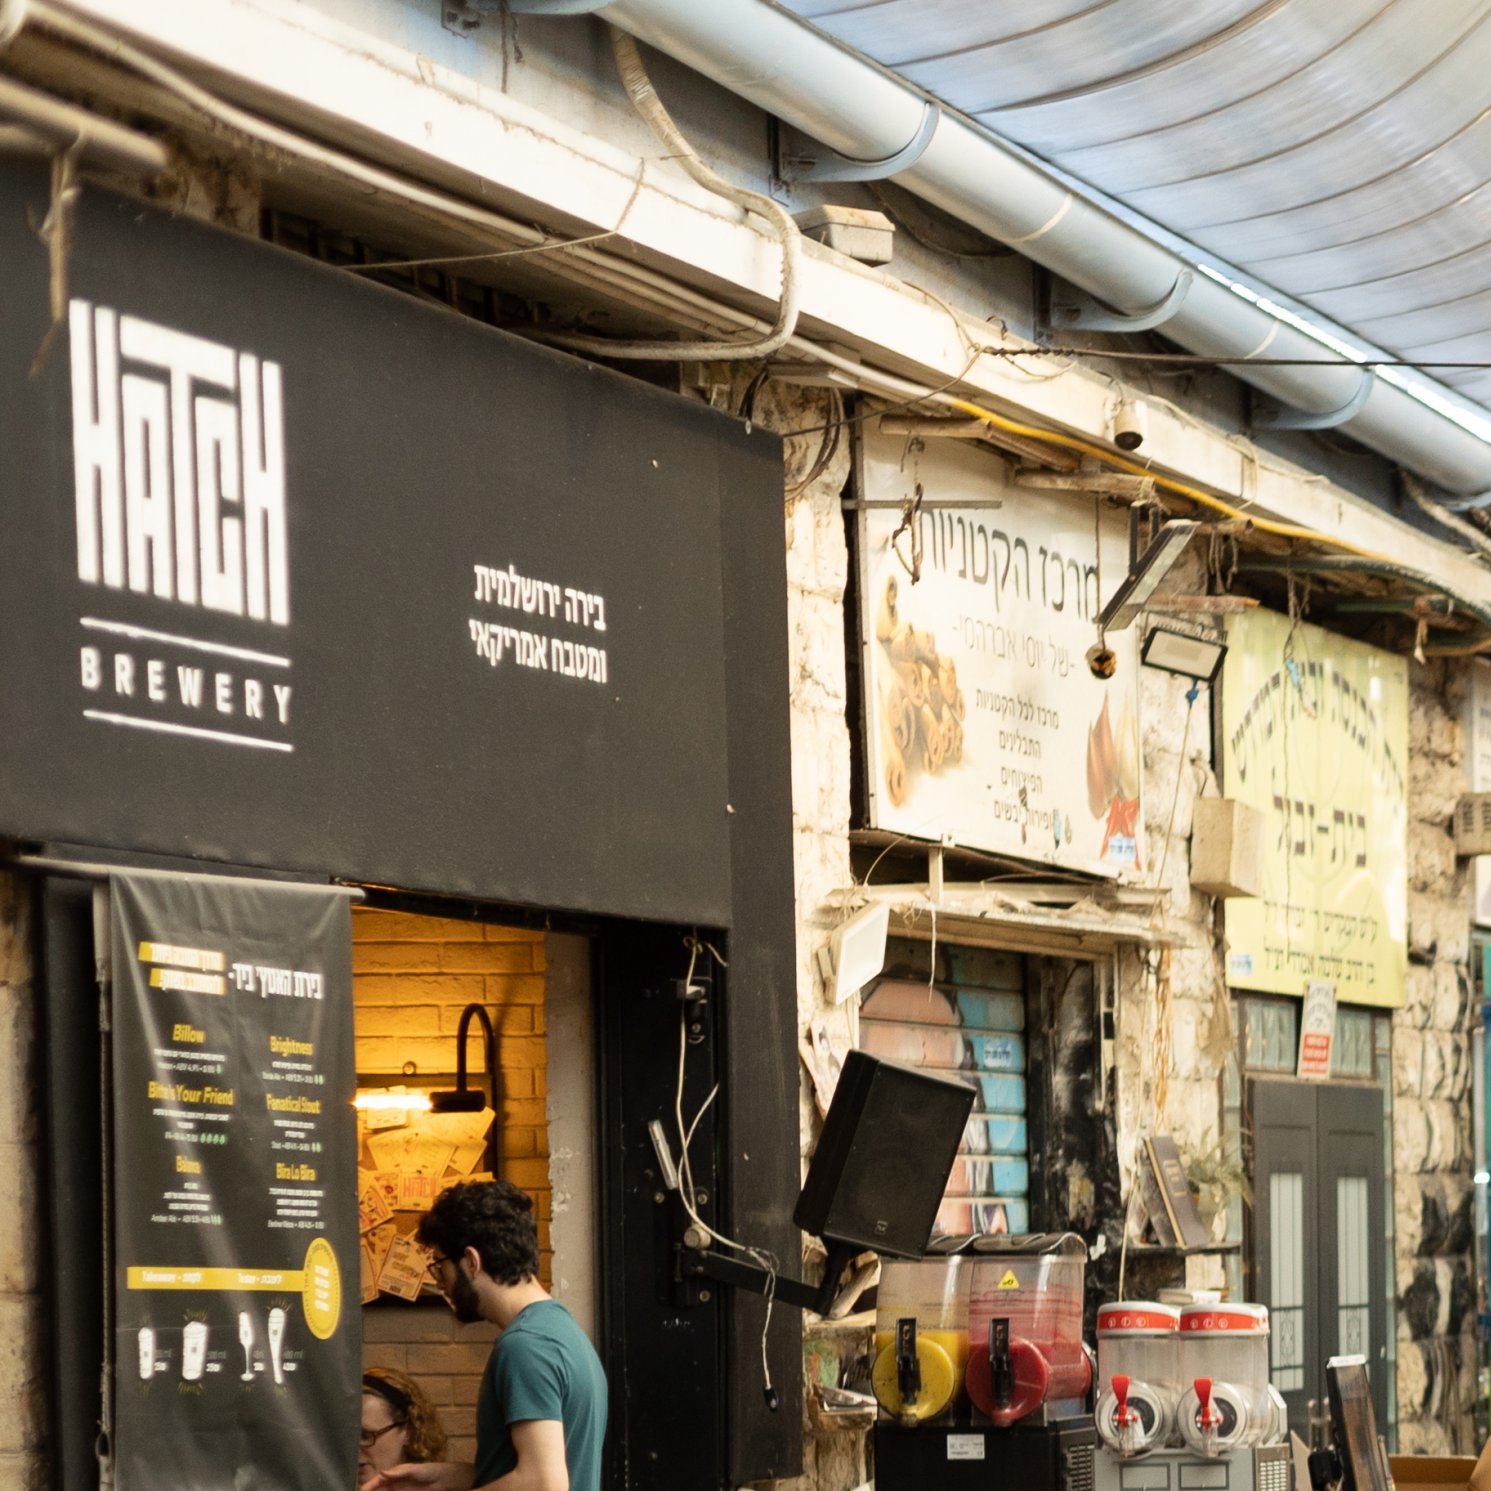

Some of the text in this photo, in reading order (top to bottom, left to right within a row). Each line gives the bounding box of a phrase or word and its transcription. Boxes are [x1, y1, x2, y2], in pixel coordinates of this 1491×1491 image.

[69, 298, 289, 625] HATCH
[919, 508, 1101, 624] מרכז הקטניות
[473, 563, 606, 631] בירה ירושלמית
[468, 618, 607, 683] ומטבח אמריקאי
[80, 646, 292, 724] BREWERY
[975, 689, 1060, 730] מרכז לכל הקטניות
[999, 728, 1042, 759] התבלינים
[1001, 766, 1043, 793] הפיצוחים
[994, 800, 1022, 824] יבשים
[175, 1084, 202, 1103] Your
[202, 1086, 235, 1106] Friend
